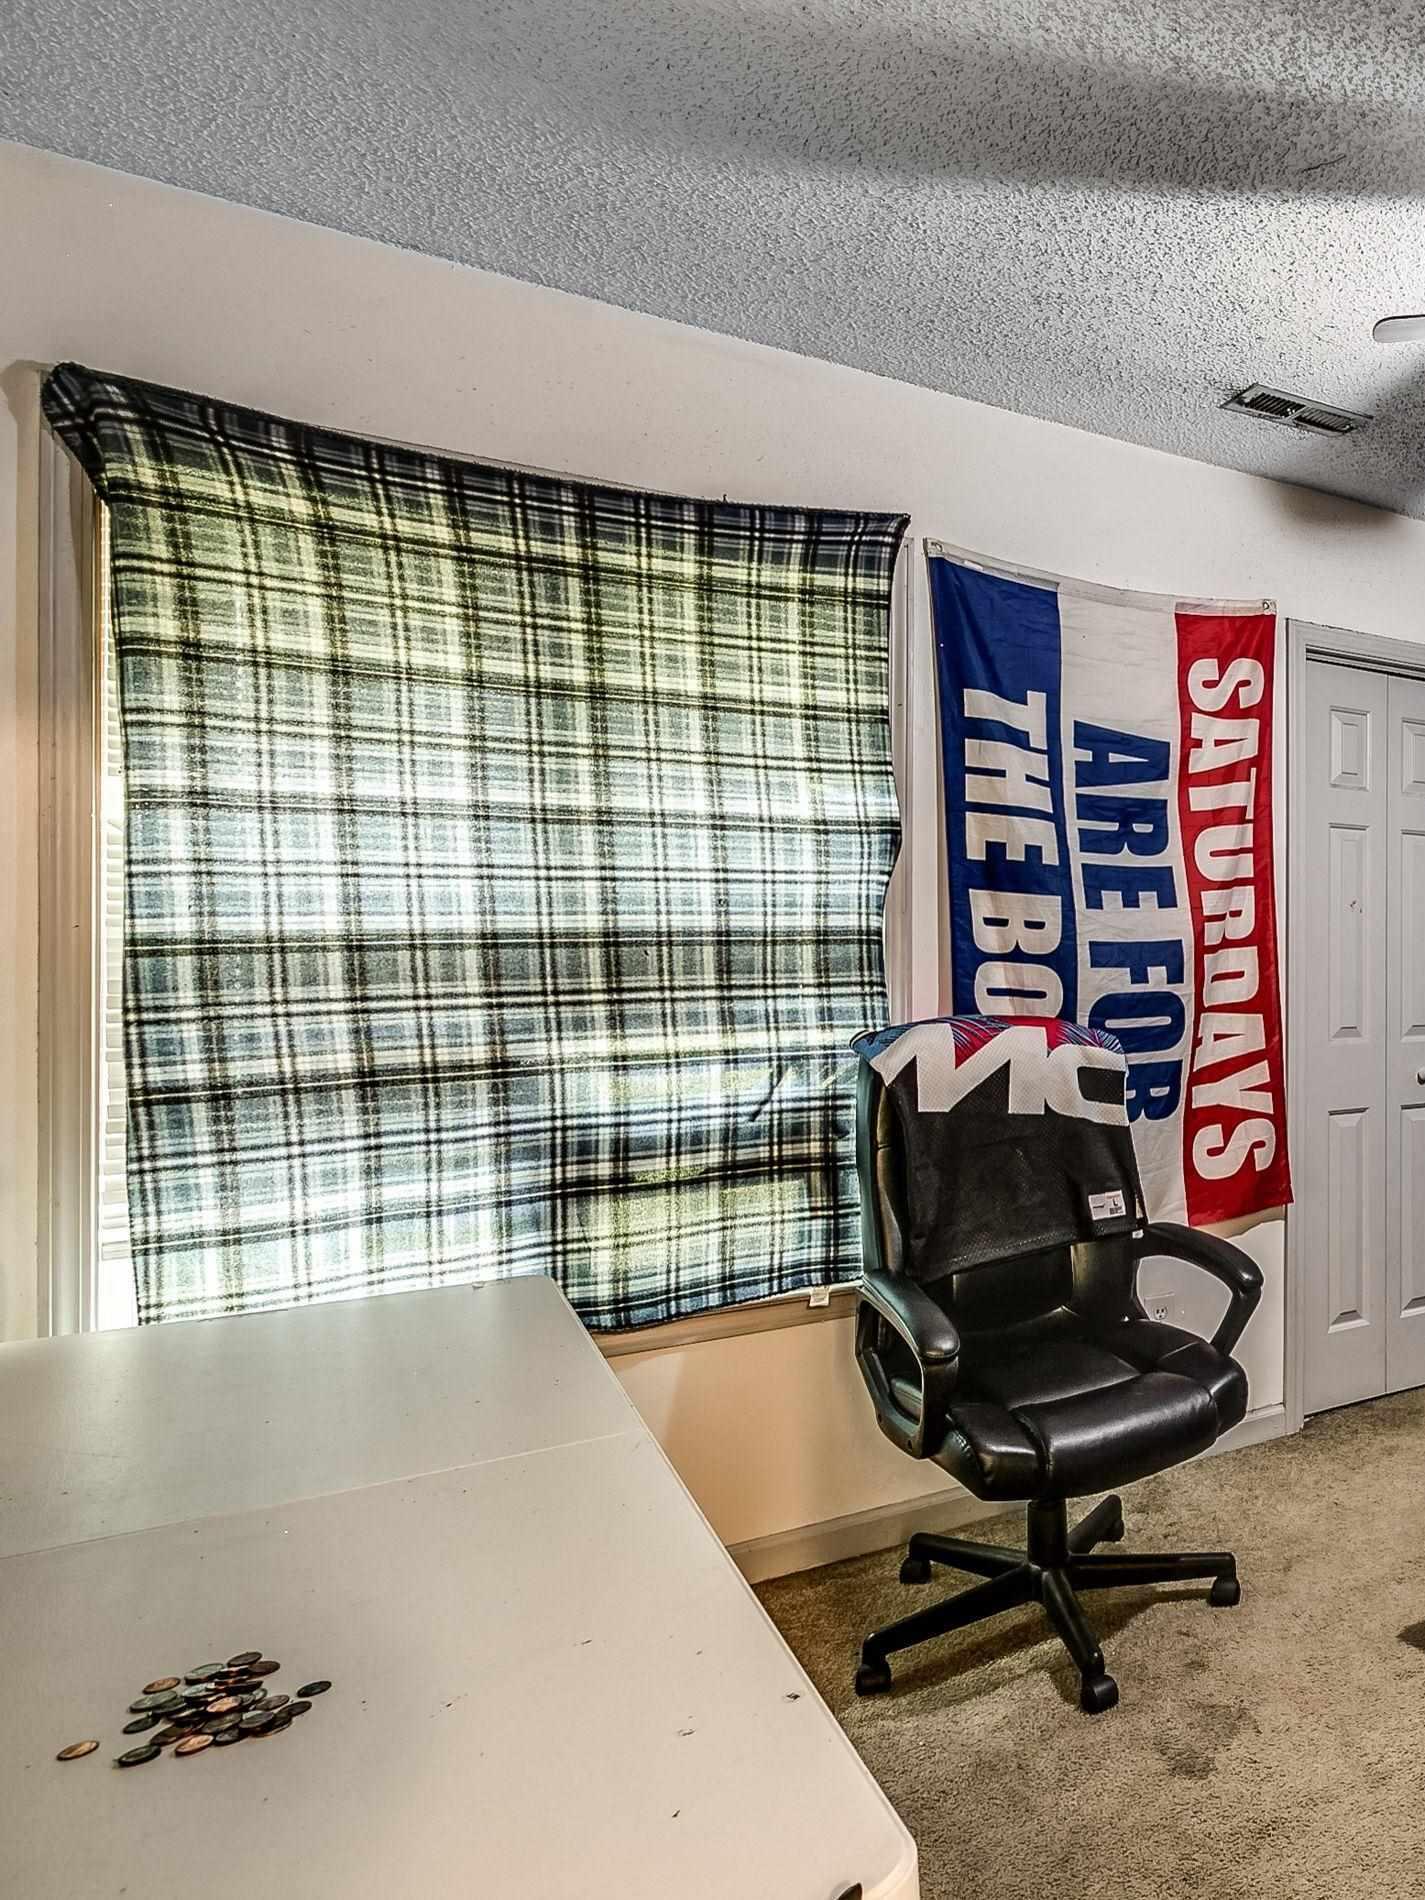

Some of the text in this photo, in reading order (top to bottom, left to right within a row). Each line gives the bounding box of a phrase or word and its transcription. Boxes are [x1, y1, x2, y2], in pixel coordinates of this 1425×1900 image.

[963, 689, 1065, 1018] THE BO
[1073, 719, 1179, 910] ARE
[1187, 656, 1277, 1180] SATURDAYS
